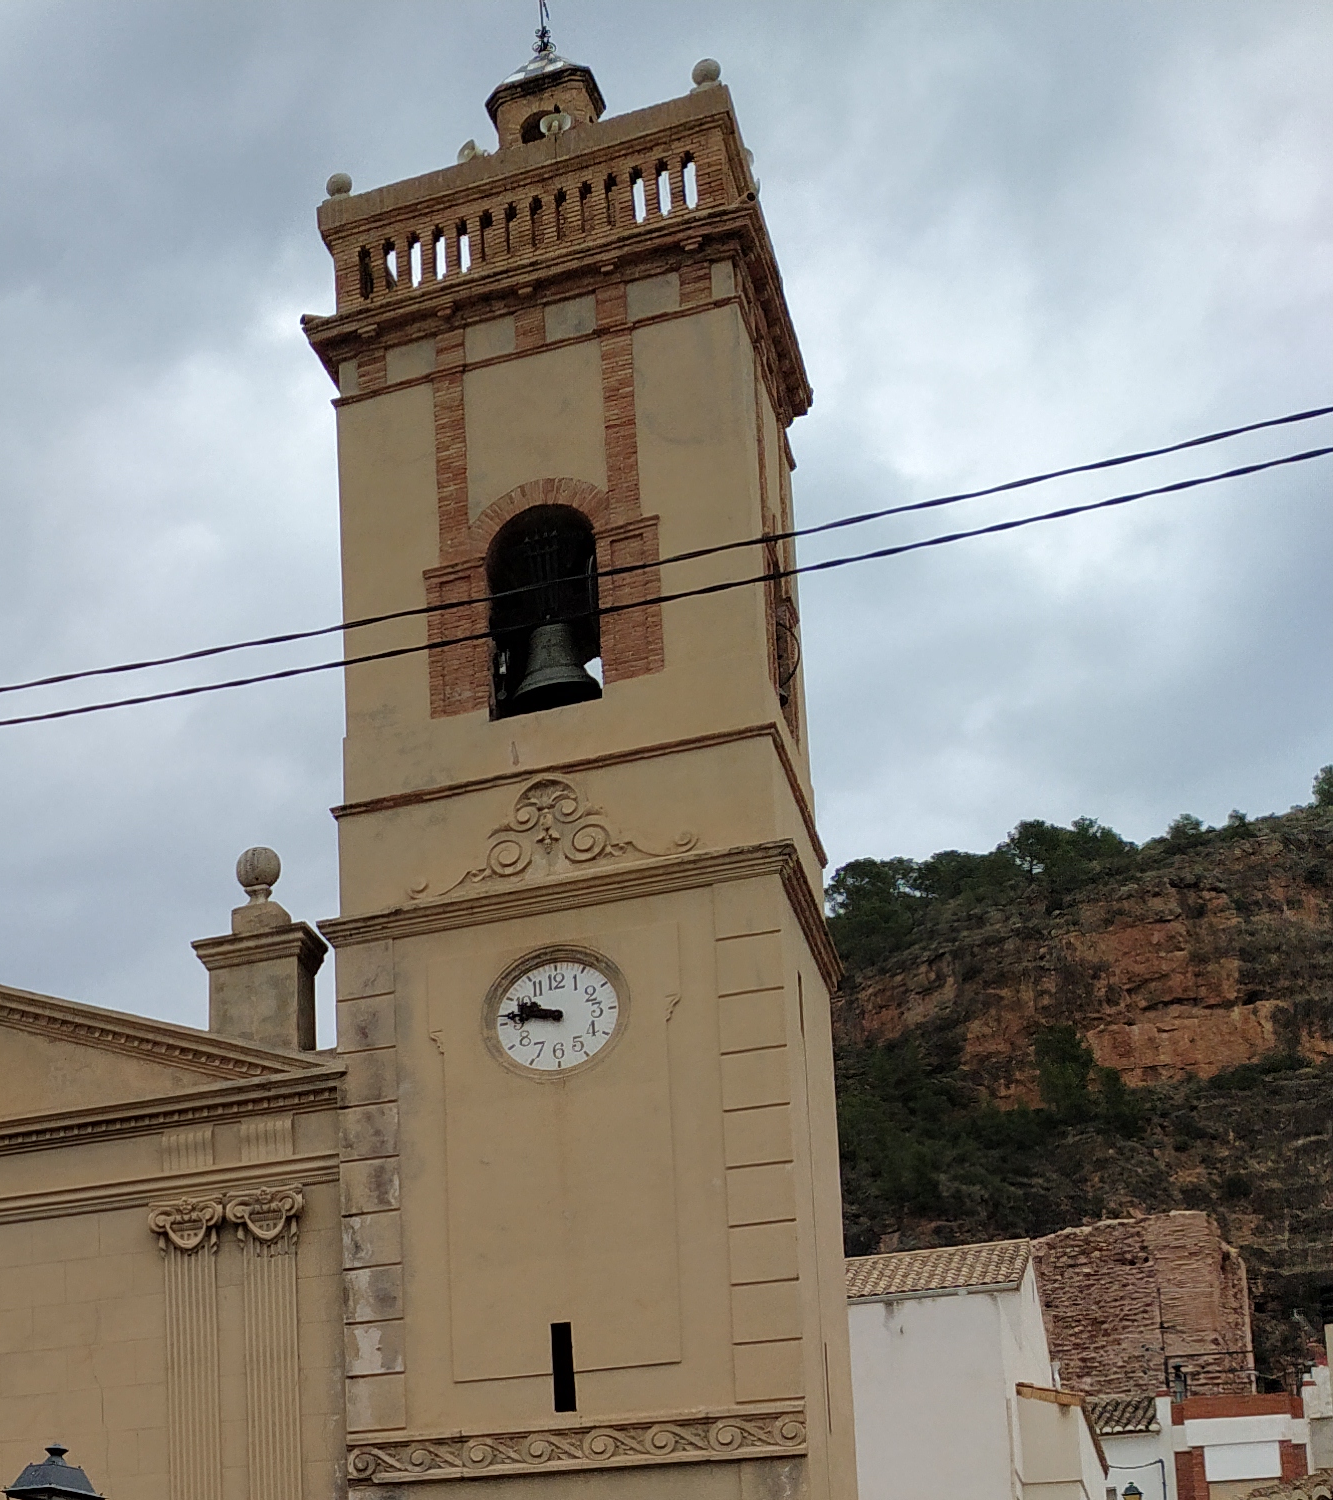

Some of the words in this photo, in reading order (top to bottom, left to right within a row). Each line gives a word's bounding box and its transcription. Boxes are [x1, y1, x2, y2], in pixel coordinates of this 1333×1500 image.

[533, 980, 543, 997] 11
[547, 972, 566, 991] 12
[572, 974, 578, 991] 1
[584, 985, 597, 1003] 2
[590, 1001, 604, 1018] 3
[586, 1020, 599, 1037] 4
[519, 1030, 532, 1047] 8
[572, 1035, 585, 1052] 5
[533, 1041, 546, 1058] 7
[552, 1042, 565, 1059] 6
